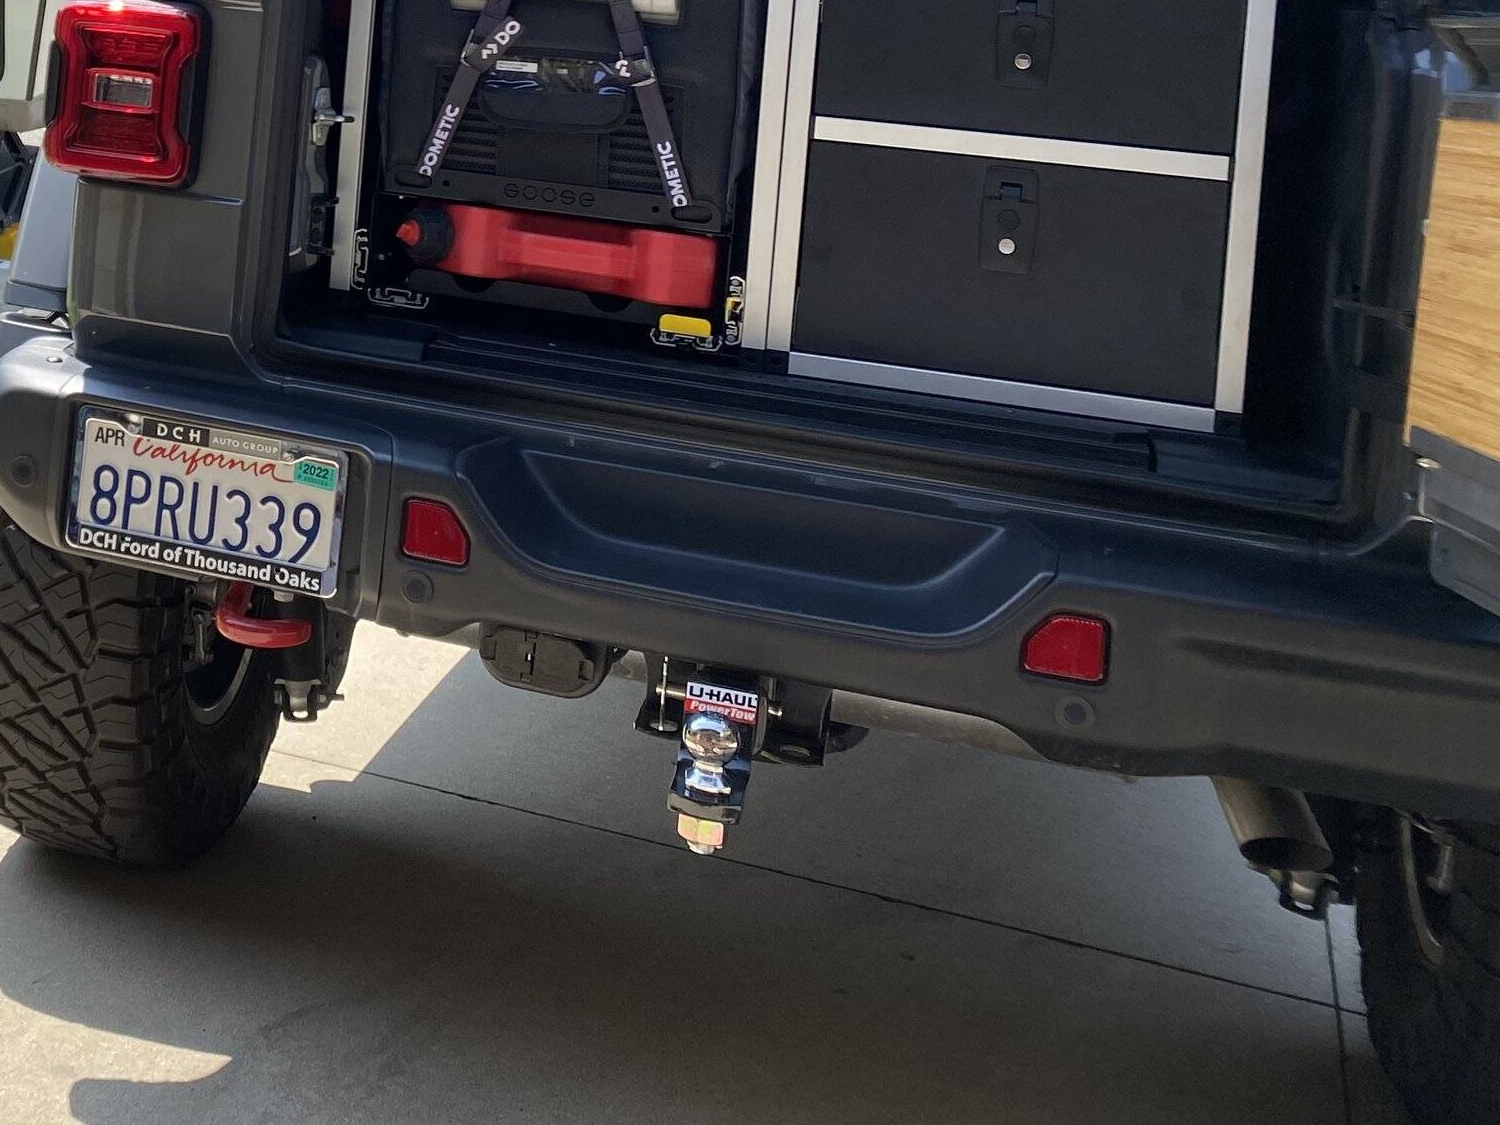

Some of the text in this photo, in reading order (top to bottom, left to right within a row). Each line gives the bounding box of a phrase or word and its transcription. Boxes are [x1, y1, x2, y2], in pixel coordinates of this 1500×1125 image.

[418, 103, 460, 176] DOMETIC
[656, 140, 688, 208] OMETIC
[94, 426, 125, 448] APR
[156, 423, 202, 444] DCH
[212, 435, 280, 456] AUTO GROUP
[132, 436, 294, 483] California
[302, 463, 330, 480] 2022
[89, 463, 322, 564] 8PRU339
[79, 527, 321, 592] DCH Ford of Thousand Oaks
[689, 685, 757, 709] U-HAUL
